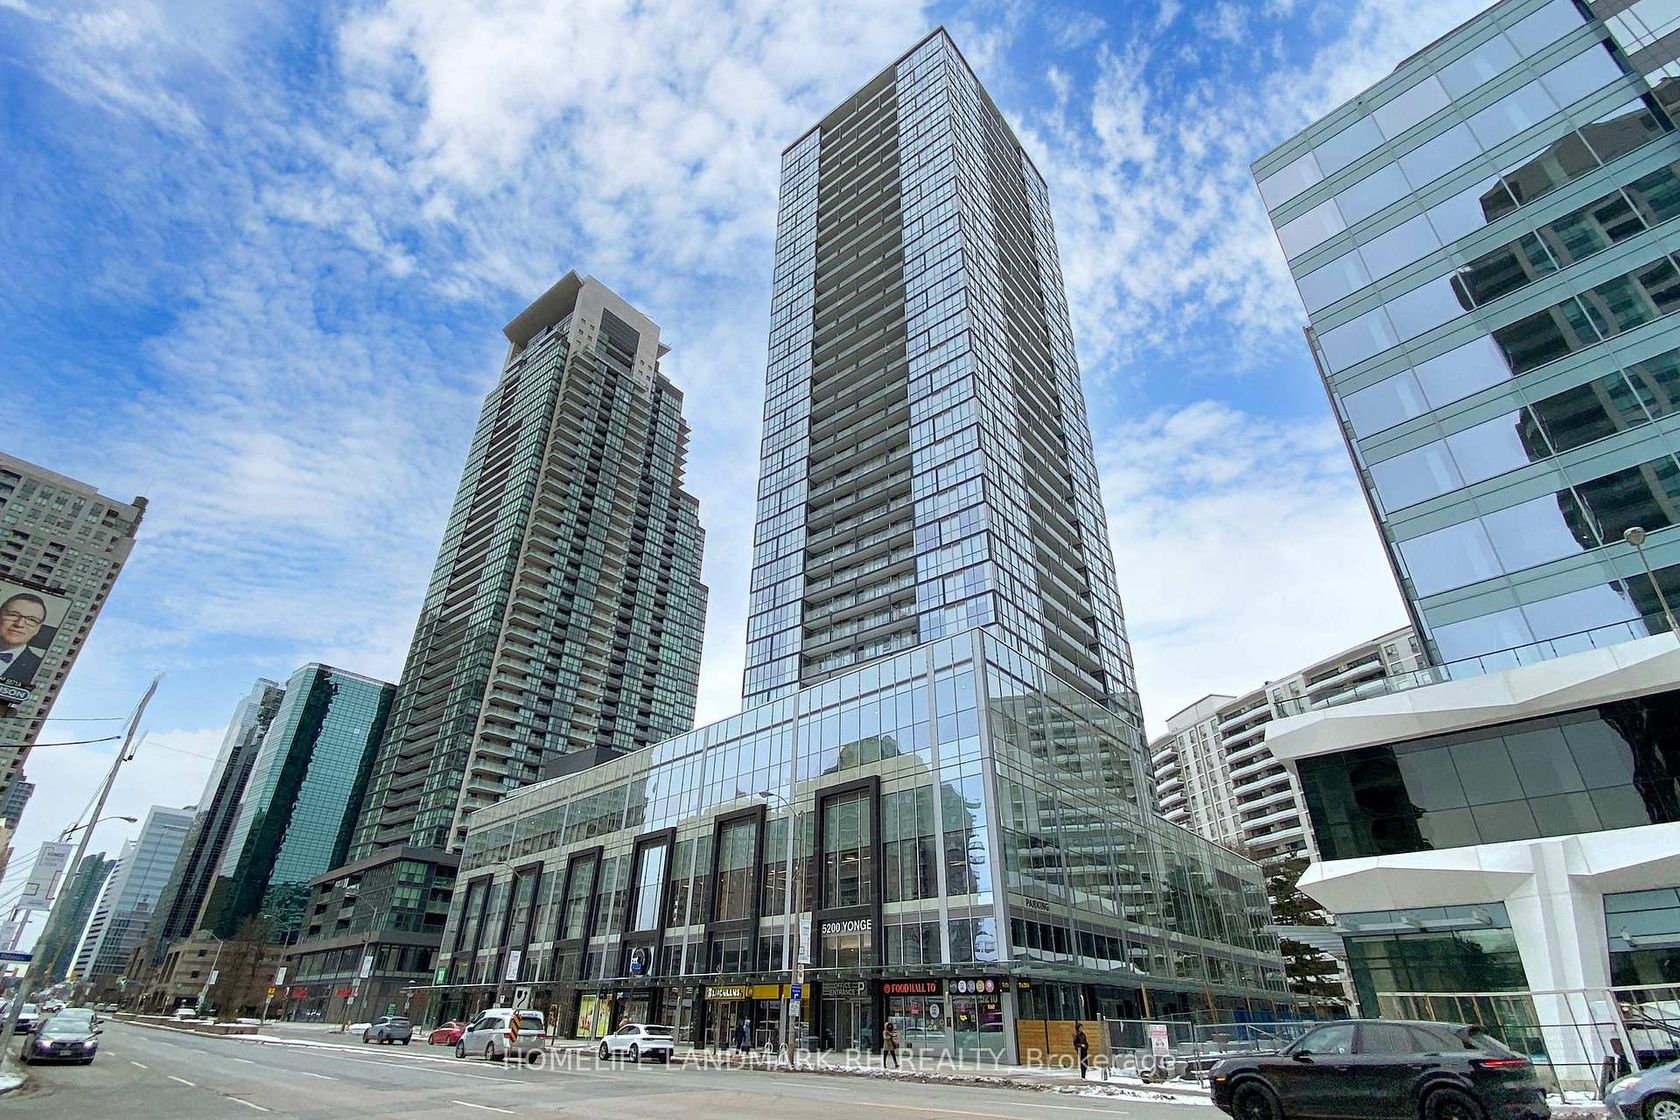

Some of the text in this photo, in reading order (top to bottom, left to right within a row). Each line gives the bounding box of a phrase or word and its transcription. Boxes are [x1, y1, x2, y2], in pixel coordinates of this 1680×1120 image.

[1025, 898, 1050, 911] PARKING
[822, 922, 840, 934] 5200
[842, 919, 872, 932] YONGE
[829, 988, 856, 996] ENTRANCE
[857, 981, 865, 996] P
[927, 982, 936, 993] TO
